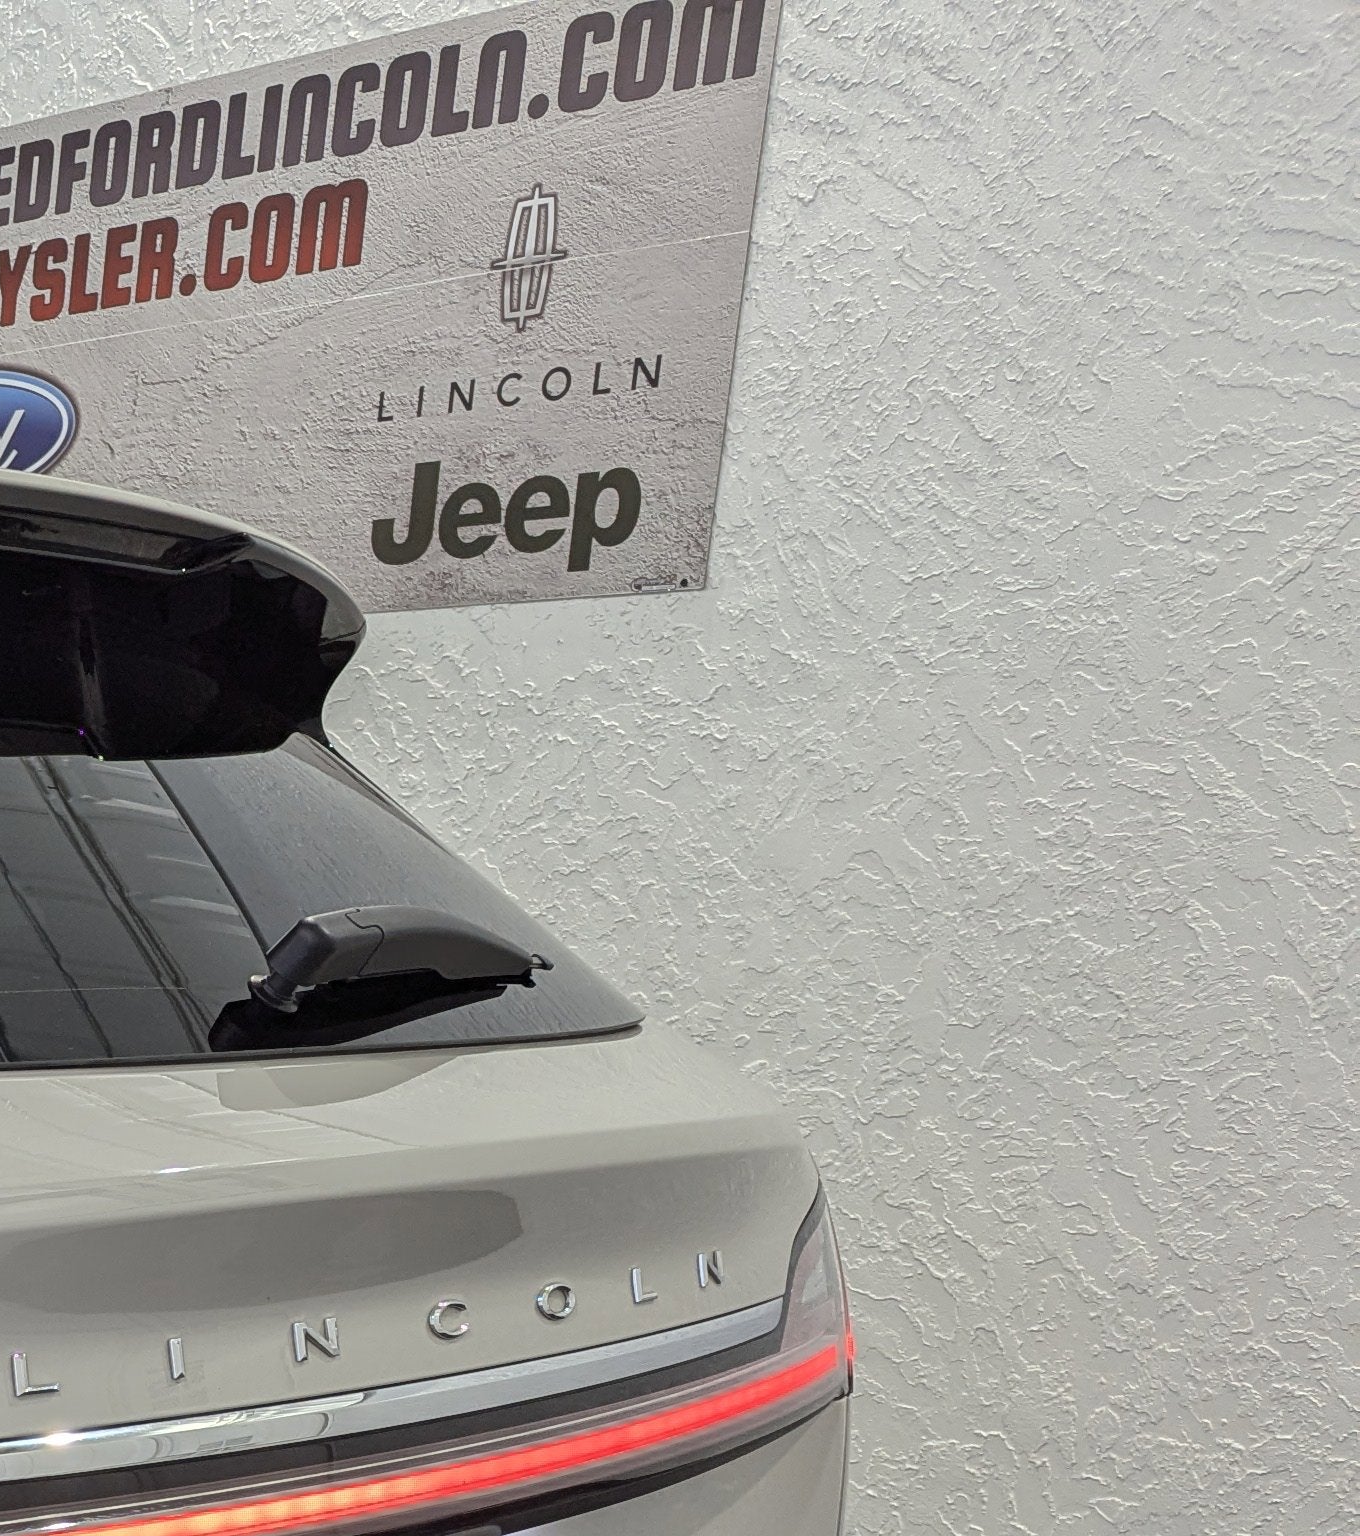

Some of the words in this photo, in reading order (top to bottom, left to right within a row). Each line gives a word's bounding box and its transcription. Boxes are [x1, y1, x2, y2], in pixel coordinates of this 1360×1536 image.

[376, 353, 663, 423] LINCOLN
[370, 460, 643, 573] Jeep
[10, 1249, 726, 1398] LINCOLN
